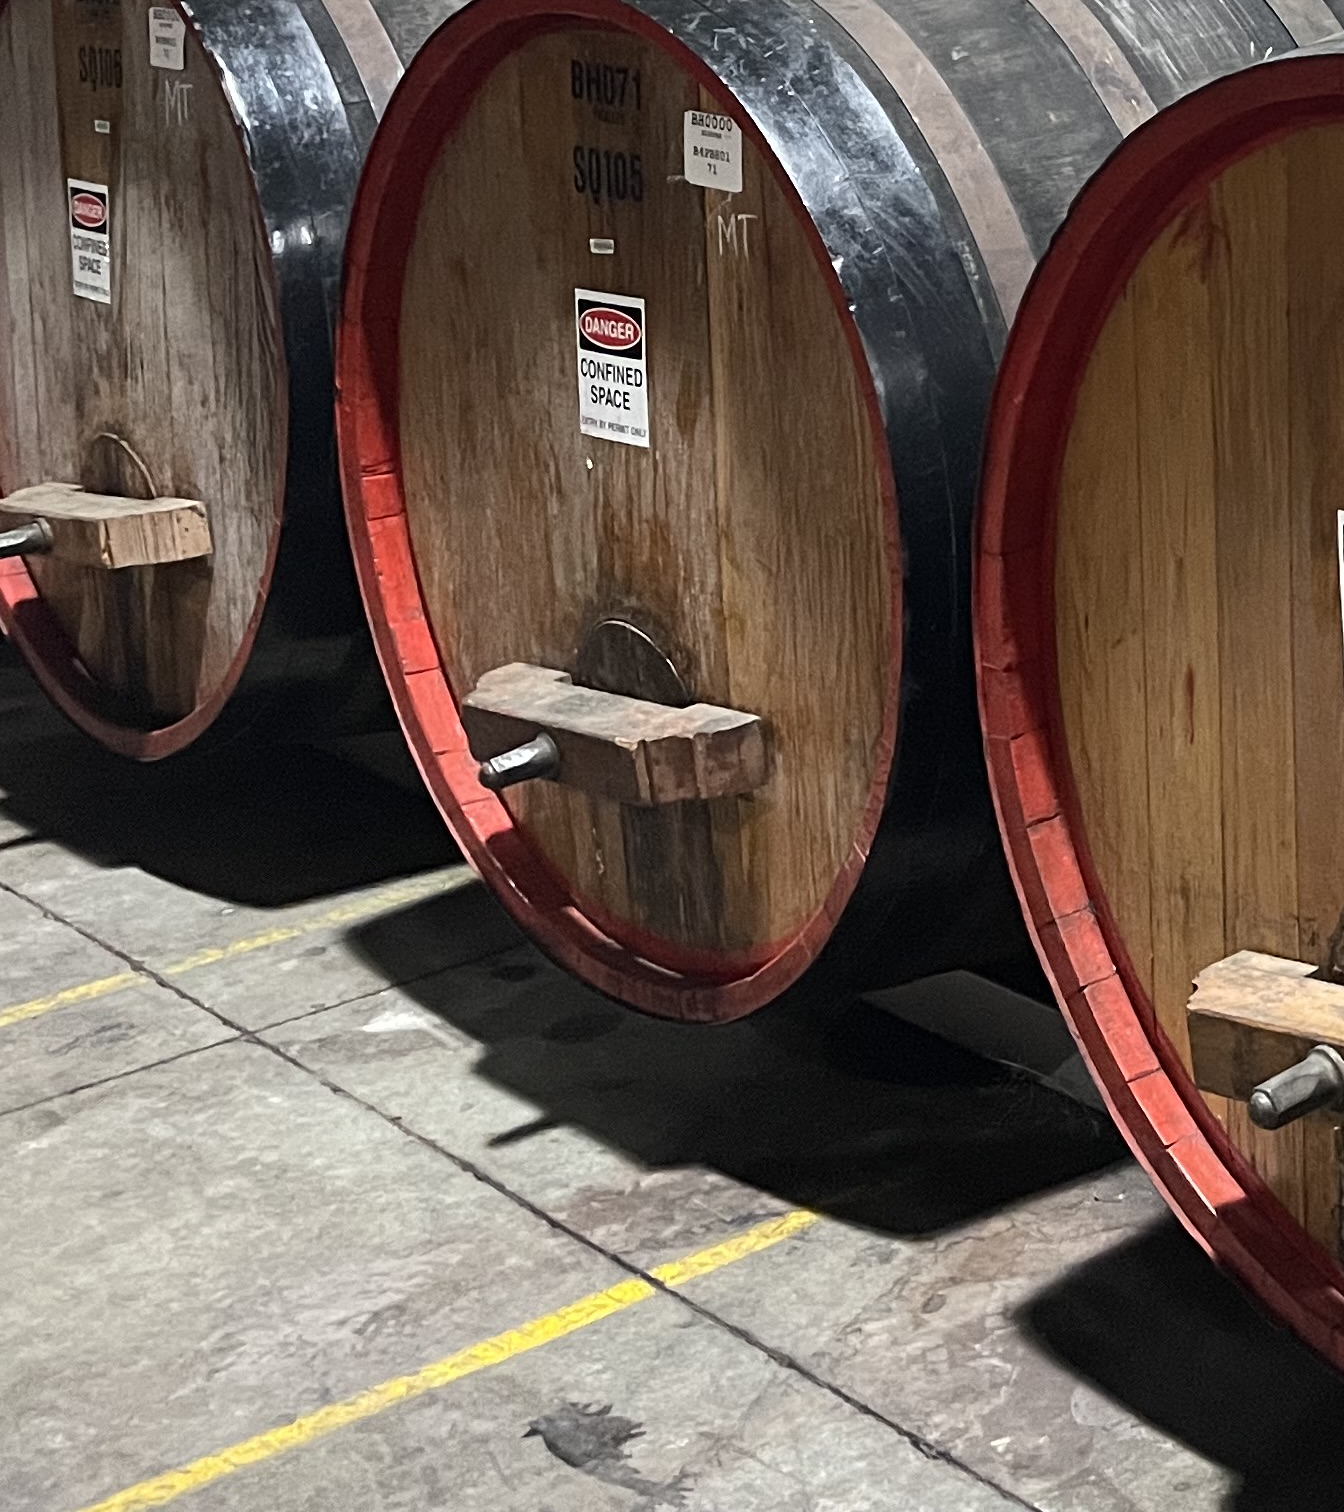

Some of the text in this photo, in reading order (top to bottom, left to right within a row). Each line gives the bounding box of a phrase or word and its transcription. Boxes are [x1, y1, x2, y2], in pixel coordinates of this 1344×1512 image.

[571, 59, 642, 110] BH071
[573, 145, 643, 204] SQ105
[718, 213, 758, 265] MT
[584, 316, 634, 342] DANGER
[580, 358, 643, 387] CONFINED
[590, 385, 631, 410] SPACE
